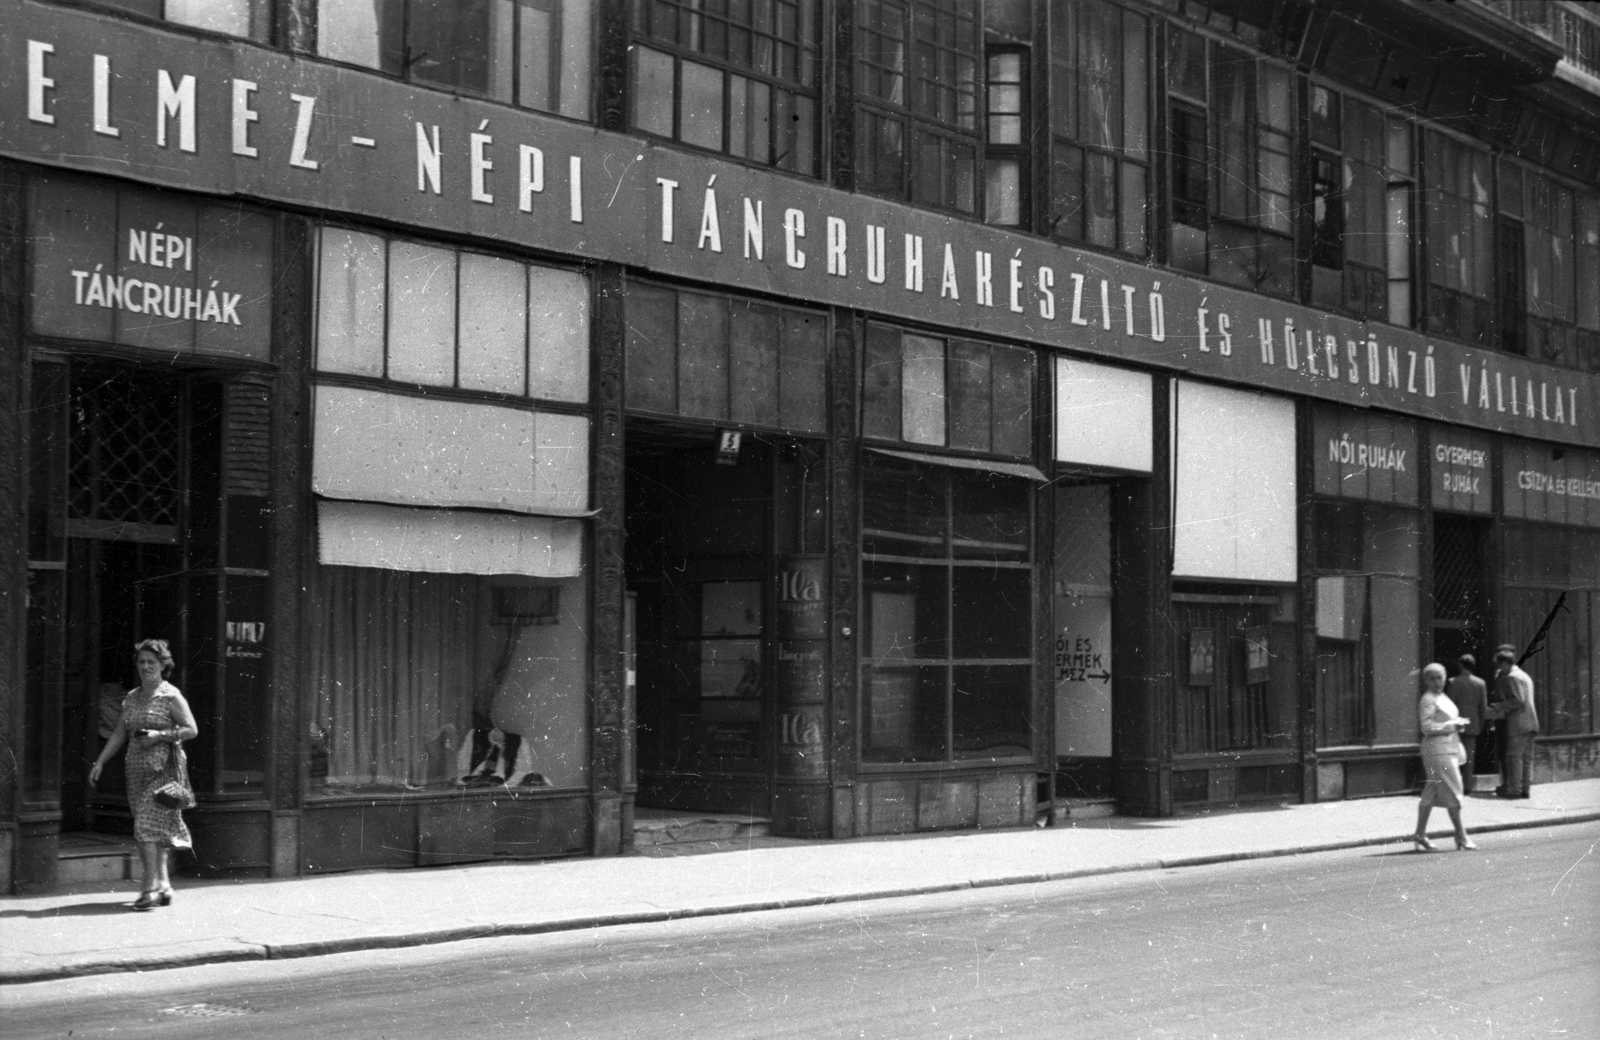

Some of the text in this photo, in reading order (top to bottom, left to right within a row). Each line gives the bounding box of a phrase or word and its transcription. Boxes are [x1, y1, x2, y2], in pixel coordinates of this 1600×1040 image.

[129, 222, 193, 271] NÉPI
[416, 119, 583, 223] NÉPI
[1197, 296, 1232, 356] ÉS
[1460, 358, 1577, 426] VÁLLALAT
[71, 263, 242, 326] TÁNCRUHÁK
[1329, 432, 1406, 472] NŐI RUHÁK
[1435, 443, 1485, 468] GYERMEK
[1443, 470, 1480, 494] RUHÁK
[1075, 634, 1092, 652] ÉS
[1055, 653, 1102, 668] ERMEK
[1057, 667, 1086, 682] MEZ
